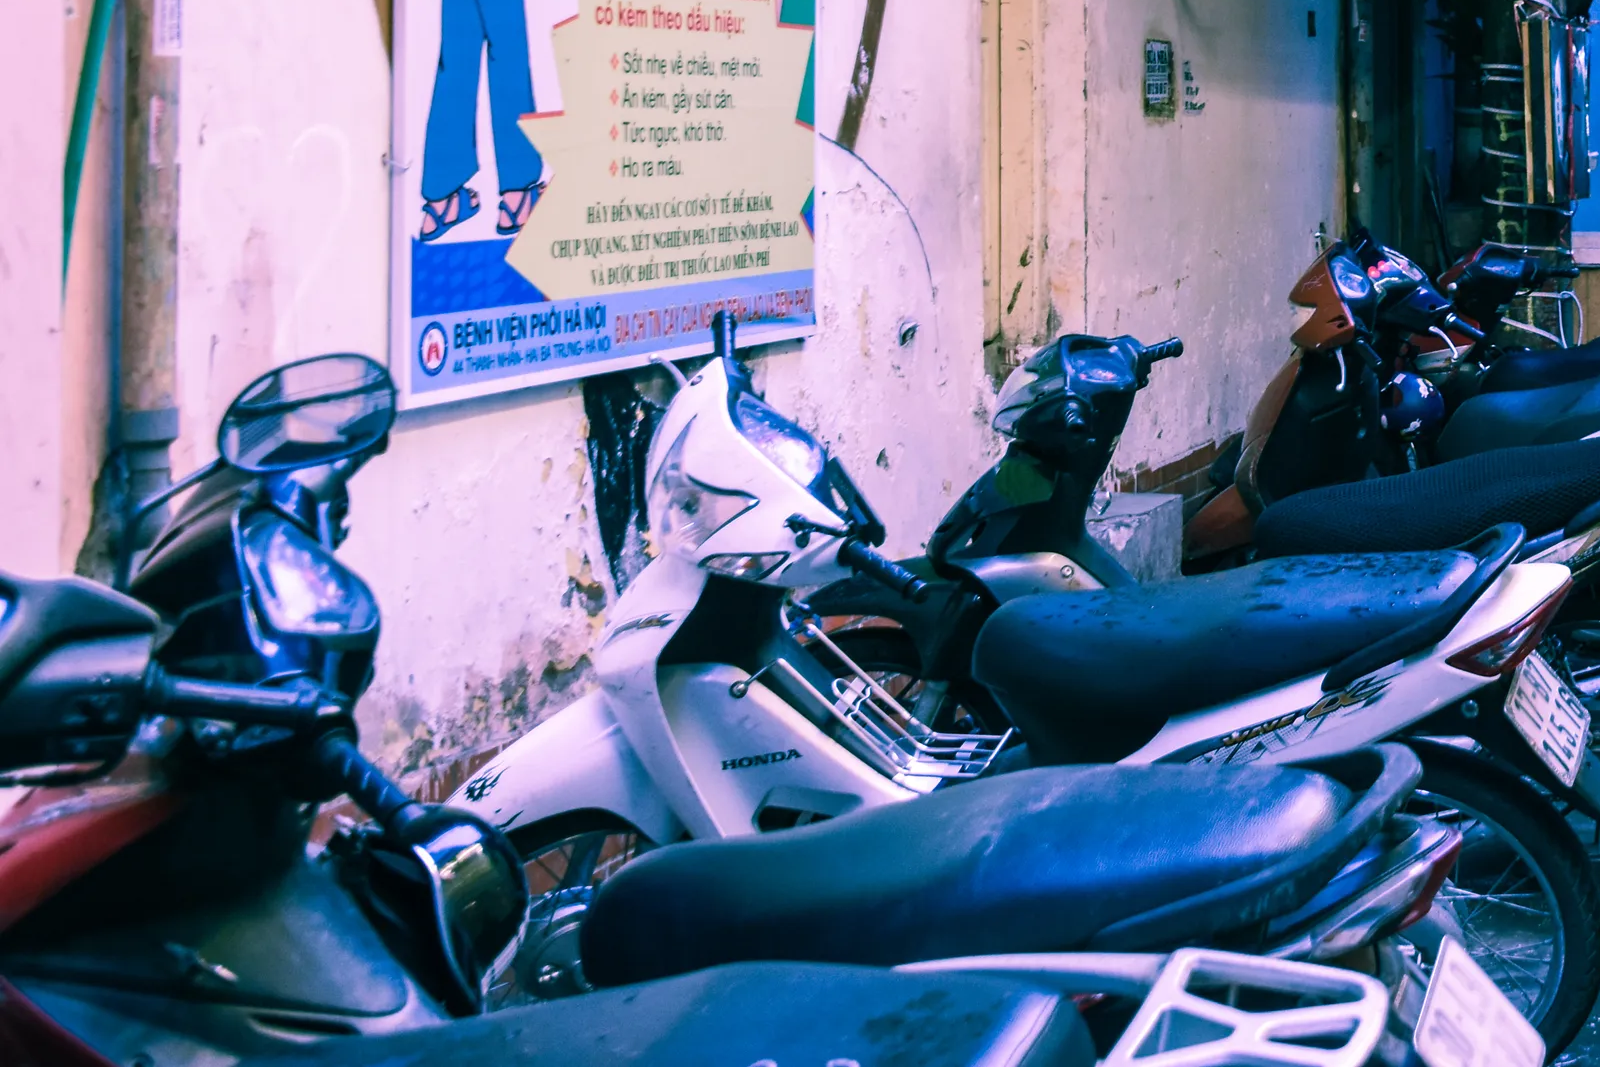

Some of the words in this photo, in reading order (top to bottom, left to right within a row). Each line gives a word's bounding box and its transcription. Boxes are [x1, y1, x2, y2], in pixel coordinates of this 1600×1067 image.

[595, 0, 613, 25] có
[618, 1, 648, 27] kèm
[653, 5, 682, 30] theo
[687, 2, 710, 32] dấu
[714, 8, 745, 39] hiệu:
[623, 48, 643, 74] Sốt
[647, 55, 667, 78] nhẹ
[671, 50, 684, 75] về
[687, 51, 718, 79] chiều,
[721, 57, 740, 80] mệt
[743, 57, 763, 77] mỏi.
[622, 82, 638, 108] Ăn
[642, 87, 669, 110] kém,
[672, 84, 692, 114] gầy
[696, 89, 712, 109] sút
[715, 89, 736, 109] cân.
[622, 121, 646, 143] Tức
[649, 126, 680, 148] ngực,
[684, 121, 703, 142] khó
[706, 120, 727, 142] thở.
[622, 157, 639, 178] Ho
[643, 161, 653, 177] ra
[657, 155, 684, 177] máu.
[586, 201, 609, 224] HÃY
[611, 197, 633, 223] ĐẾN
[634, 202, 663, 221] NGAY
[665, 197, 684, 219] CÁC
[685, 199, 698, 216] CƠ
[712, 198, 719, 214] Y
[720, 191, 732, 214] TẾ
[551, 238, 581, 261] CHỤP
[631, 230, 651, 251] XÉT
[653, 226, 691, 249] NGHIỆM
[692, 226, 716, 246] PHÁT
[718, 222, 739, 243] HIỆN
[740, 219, 759, 240] SỚM
[760, 218, 782, 241] BỆNH
[783, 220, 799, 237] LAO
[591, 262, 605, 285] VÀ
[608, 263, 637, 286] ĐƯỢC
[638, 255, 662, 281] ĐIỀU
[664, 261, 680, 280] TRỊ
[681, 251, 713, 275] THUỐC
[714, 255, 731, 272] LAO
[733, 244, 755, 270] MIỄN
[756, 246, 770, 267] PHÍ
[454, 318, 493, 354] BỆNH
[496, 313, 528, 349] VIỆN
[530, 305, 561, 337] PHỔI
[564, 302, 582, 331] HÀ
[584, 302, 606, 335] NỘI
[721, 748, 803, 771] HONDA
